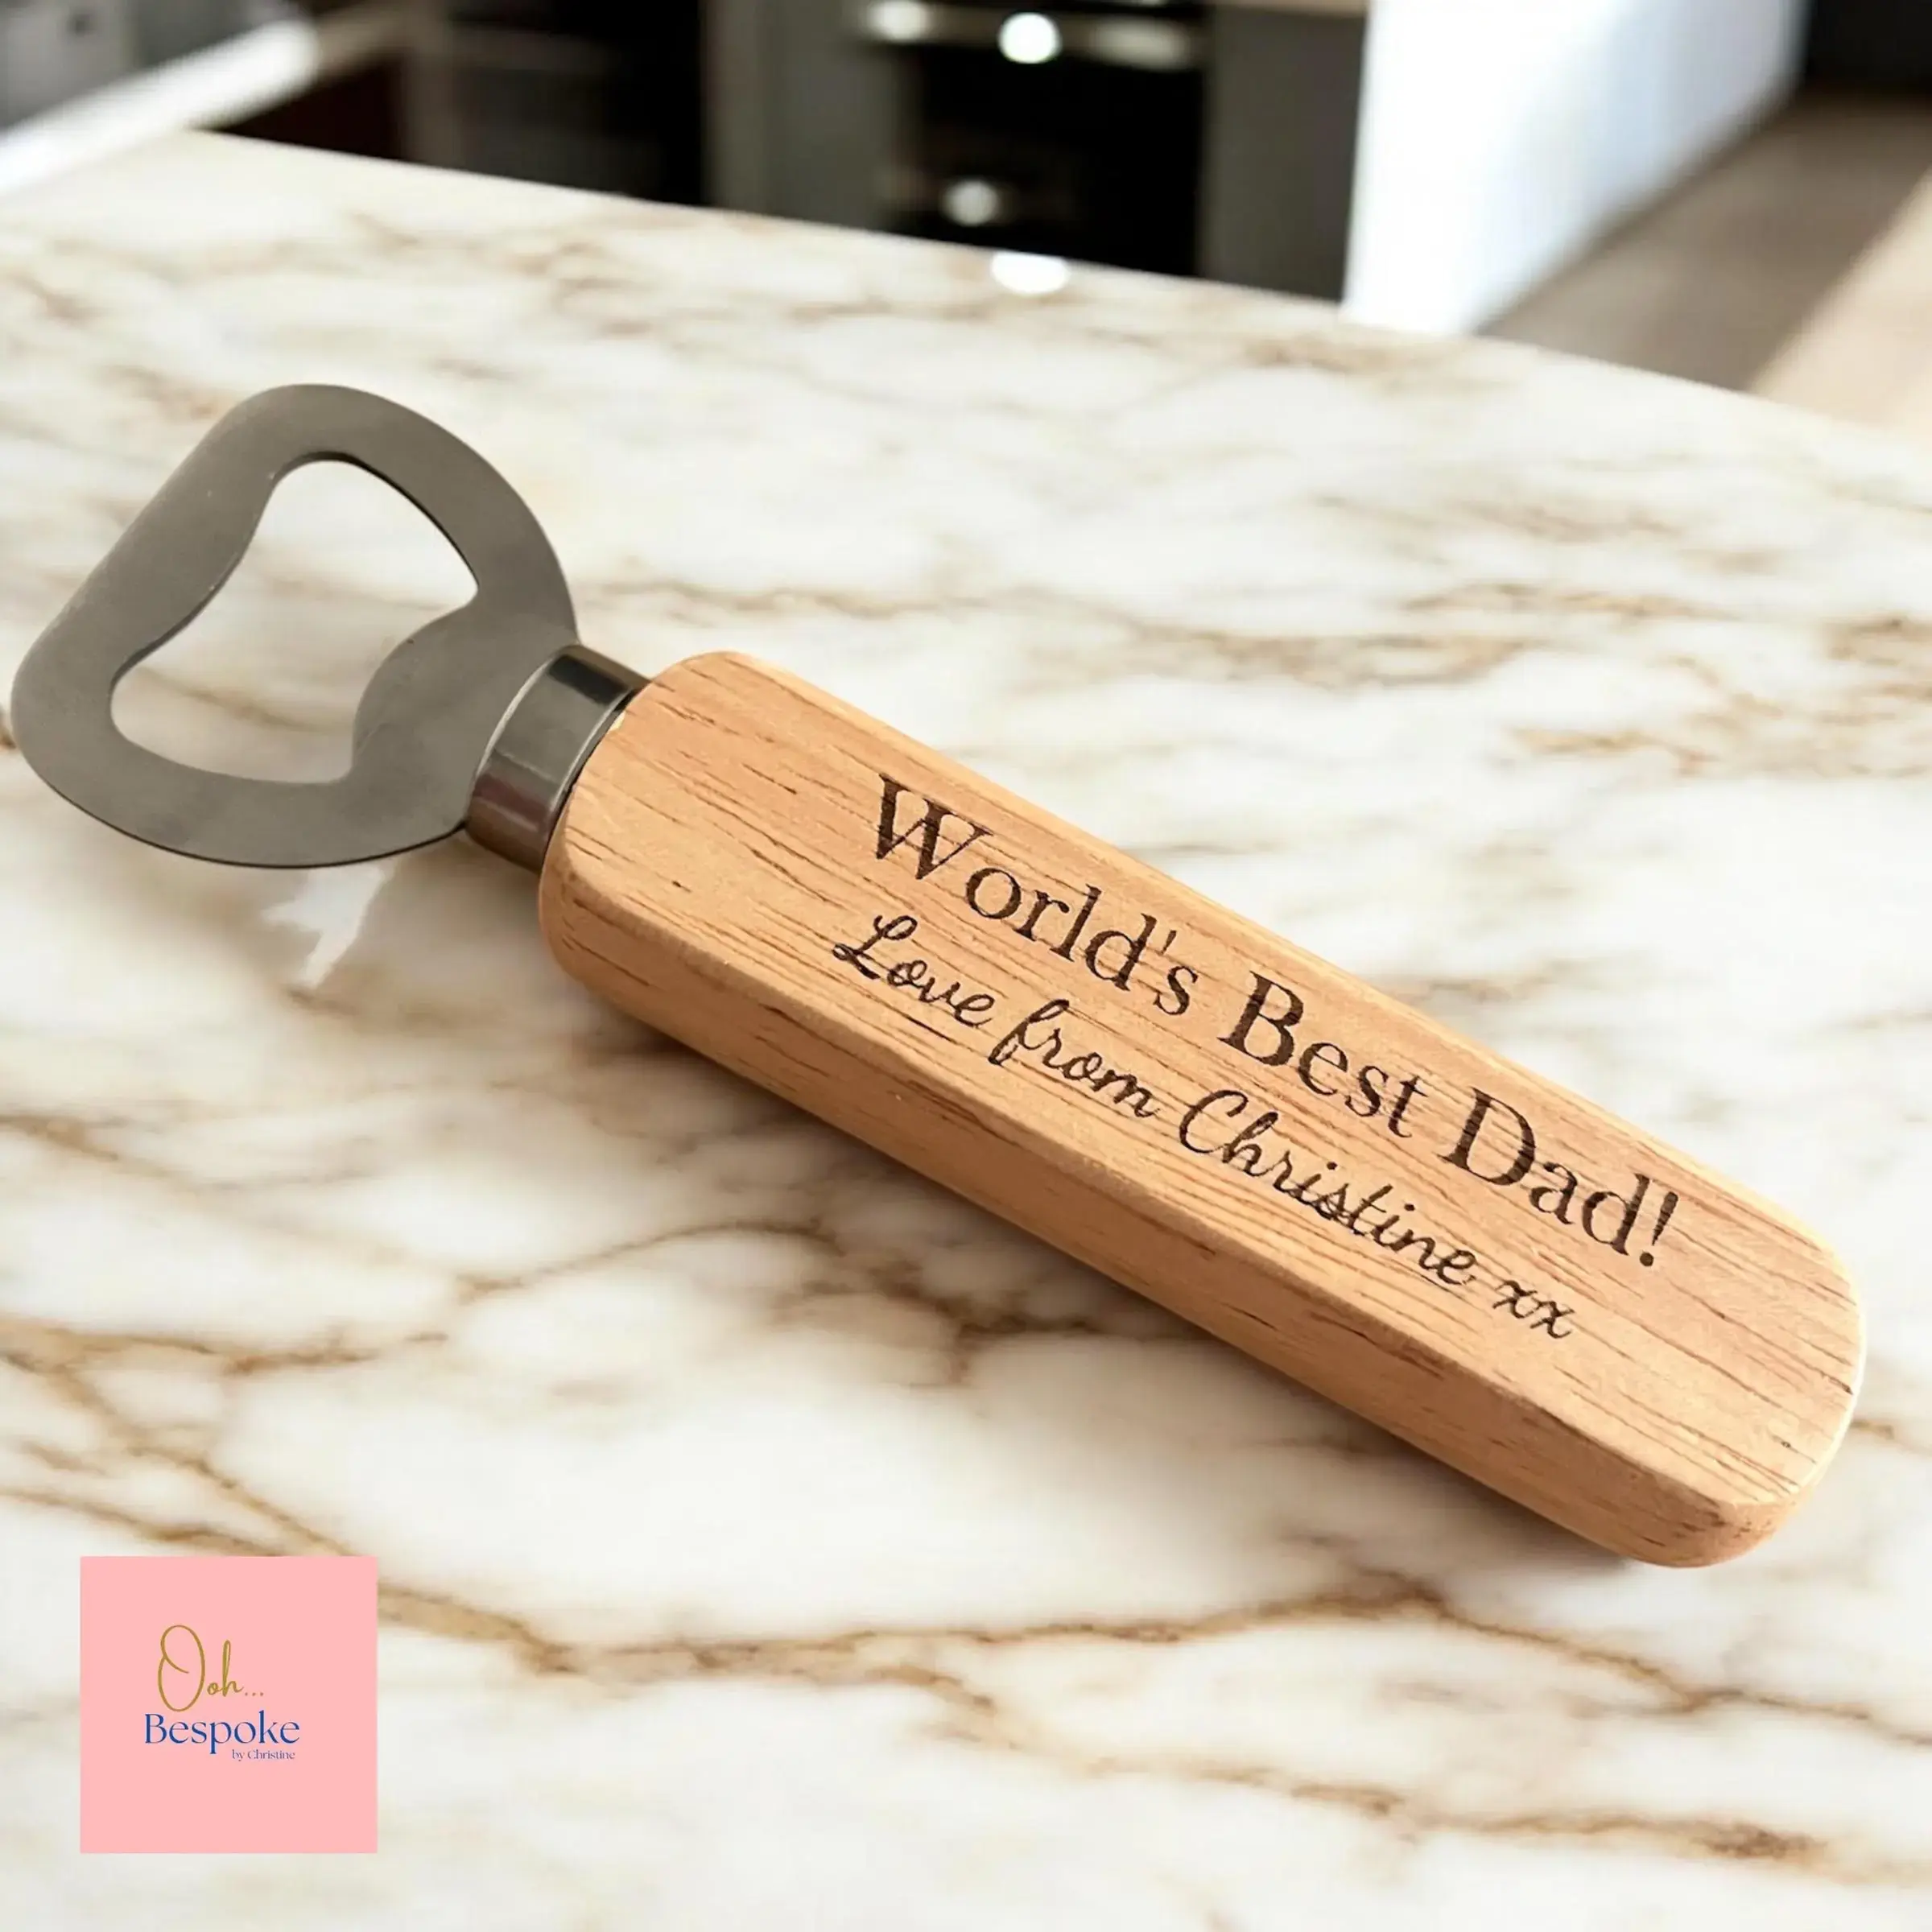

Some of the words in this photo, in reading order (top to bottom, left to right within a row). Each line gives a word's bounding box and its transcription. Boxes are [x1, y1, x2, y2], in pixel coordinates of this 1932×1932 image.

[832, 914, 995, 1029] Love
[987, 999, 1161, 1118] from
[1178, 1088, 1477, 1286] Christine
[1492, 1279, 1575, 1340] xx
[875, 772, 1199, 1016] World's
[1217, 970, 1428, 1138] Best
[1437, 1086, 1679, 1267] Dad!
